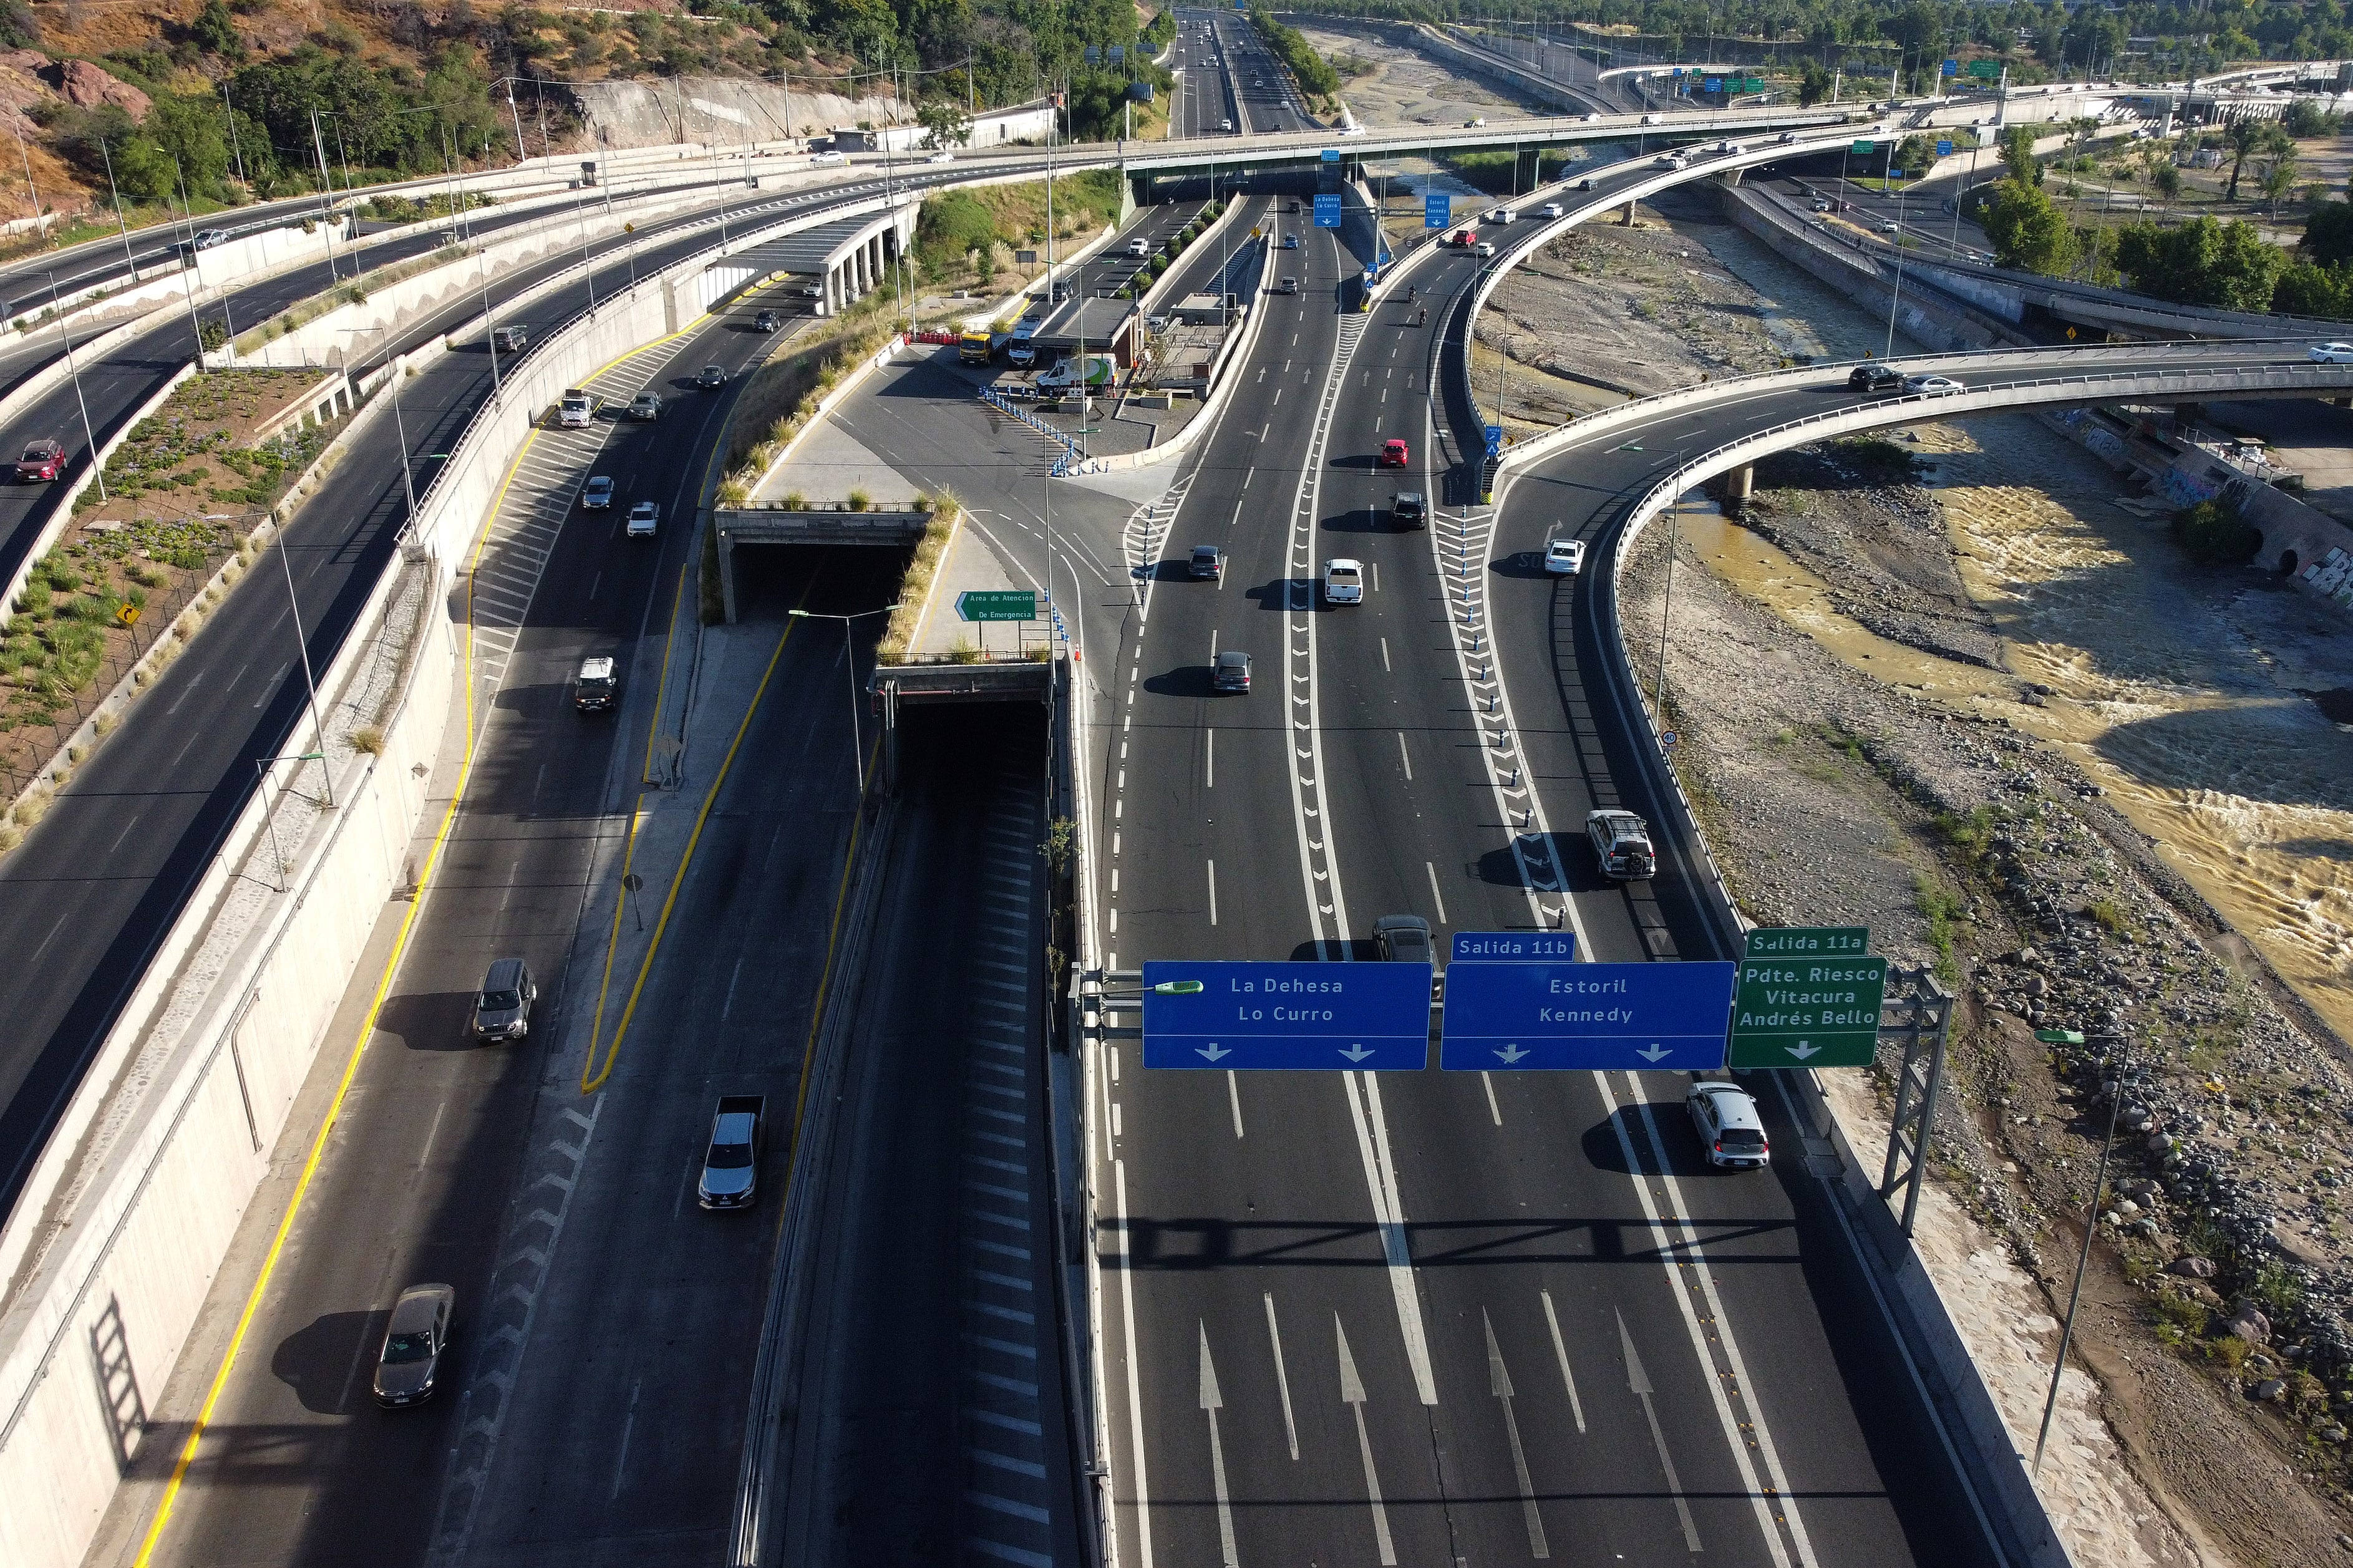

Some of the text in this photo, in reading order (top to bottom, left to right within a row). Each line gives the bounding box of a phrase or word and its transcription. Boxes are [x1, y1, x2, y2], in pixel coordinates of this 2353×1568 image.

[1002, 593, 1034, 601] Atención
[990, 611, 1031, 619] Emergencia
[1460, 940, 1567, 954] Salida 11b
[1754, 935, 1861, 950] Salida 11a
[1745, 967, 1879, 983] Pdte. Riesco
[1231, 978, 1342, 992] La Dehesa
[1550, 979, 1627, 994] Estoril
[1766, 990, 1855, 1004] Vitacura
[1239, 1006, 1333, 1020] Lo Curro
[1540, 1007, 1633, 1024] Kennedy
[1739, 1010, 1875, 1026] Andrés Bello
